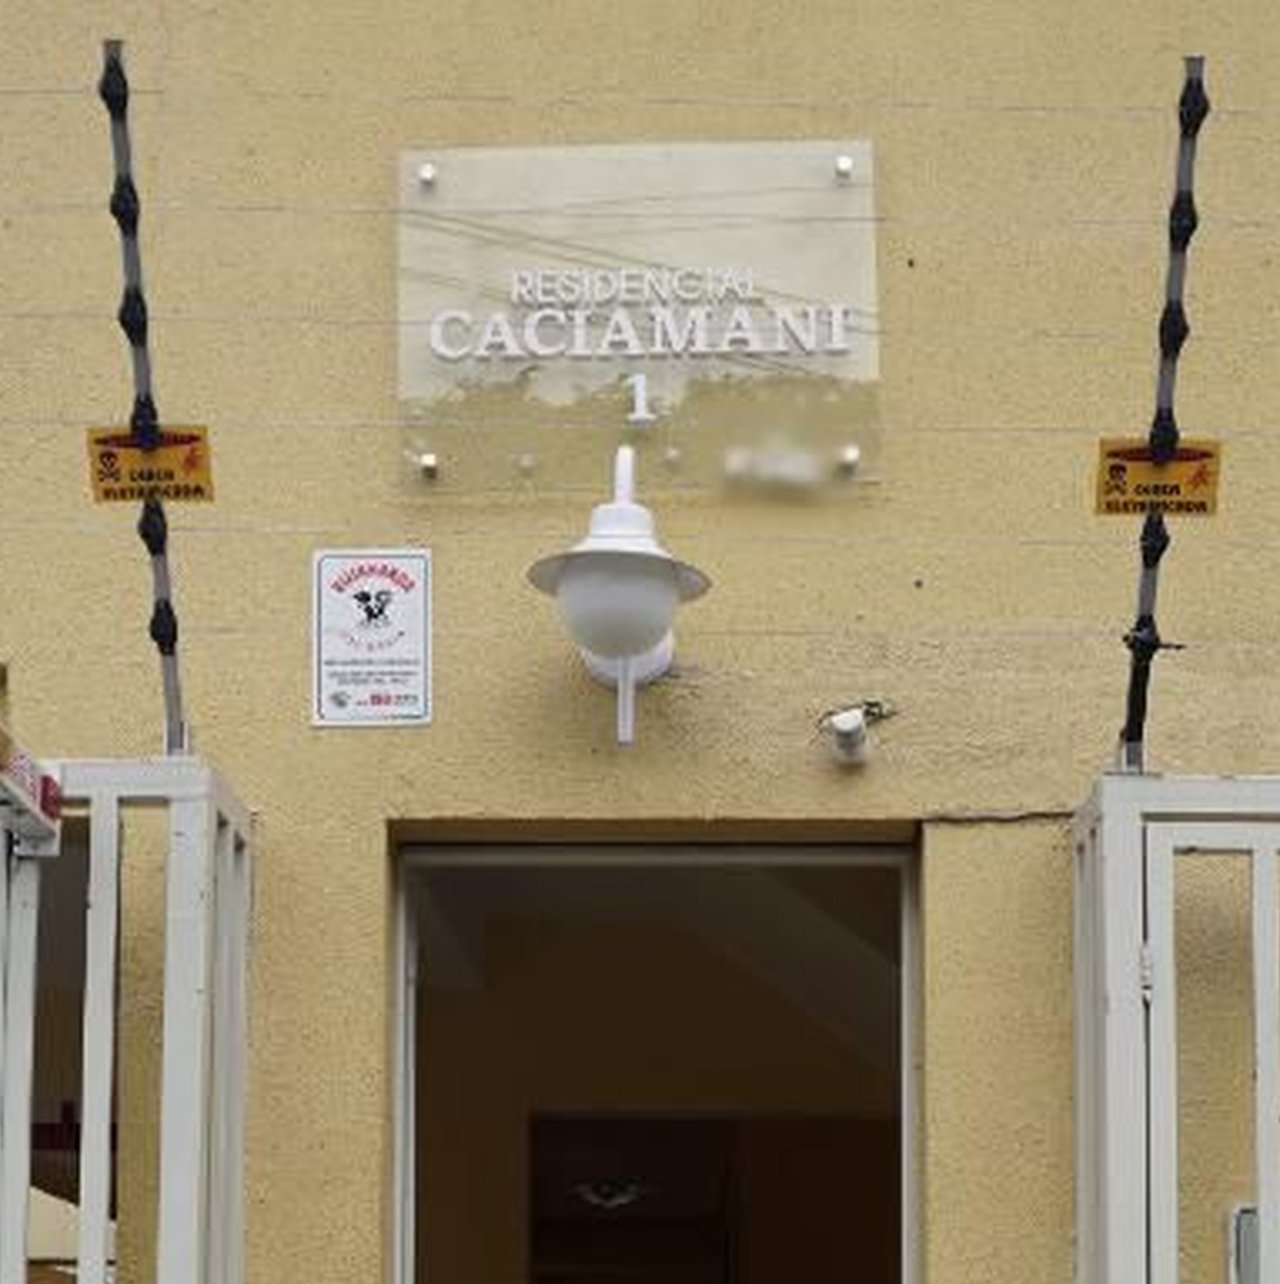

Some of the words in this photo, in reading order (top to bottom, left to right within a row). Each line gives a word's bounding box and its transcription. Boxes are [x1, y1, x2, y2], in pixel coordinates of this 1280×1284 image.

[510, 266, 757, 303] RESIDENCIAL
[429, 304, 854, 358] CACIAMANI
[625, 374, 656, 422] 1
